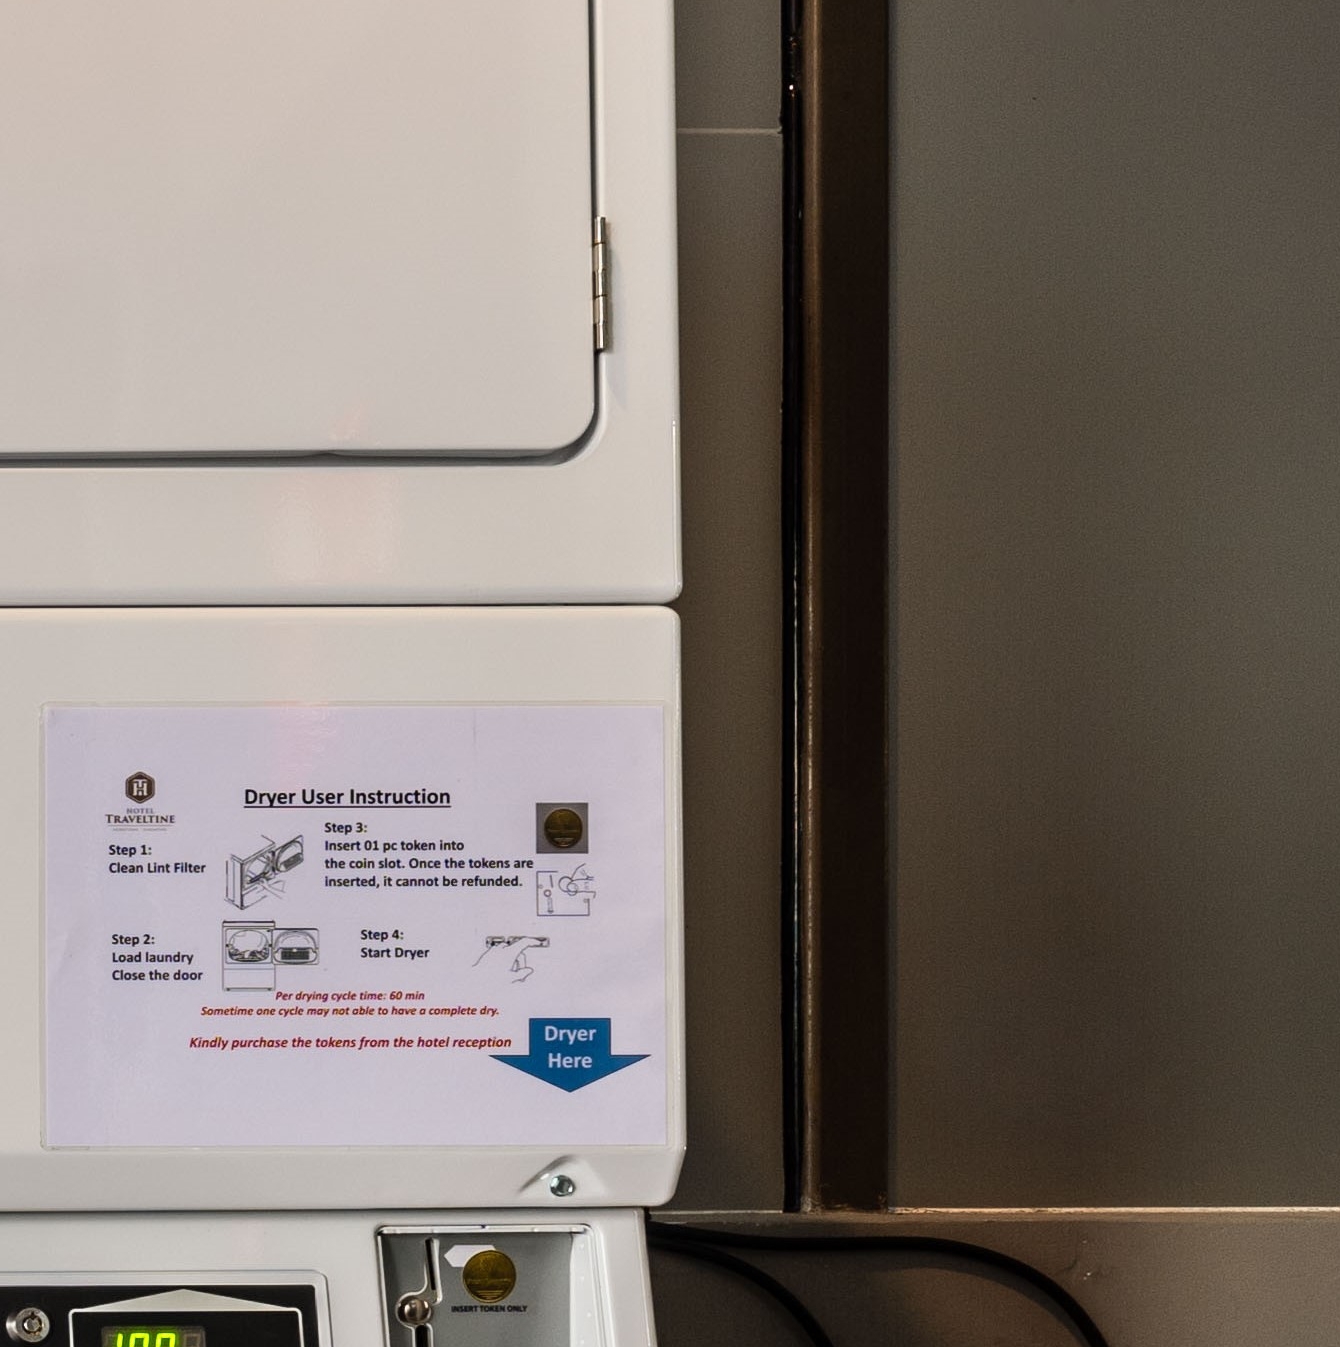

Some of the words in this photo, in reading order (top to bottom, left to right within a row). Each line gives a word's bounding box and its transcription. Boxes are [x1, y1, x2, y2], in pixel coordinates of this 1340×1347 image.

[245, 789, 296, 806] Dryer
[302, 789, 344, 804] User
[350, 789, 450, 804] Instruction
[106, 814, 174, 823] TRAVELTINE
[109, 845, 136, 857] Step
[141, 845, 151, 855] 1:
[109, 862, 143, 873] Clean
[148, 863, 170, 873] Lint
[174, 862, 206, 873] Filter
[545, 1026, 596, 1044] Dryer
[549, 1053, 592, 1068] Here
